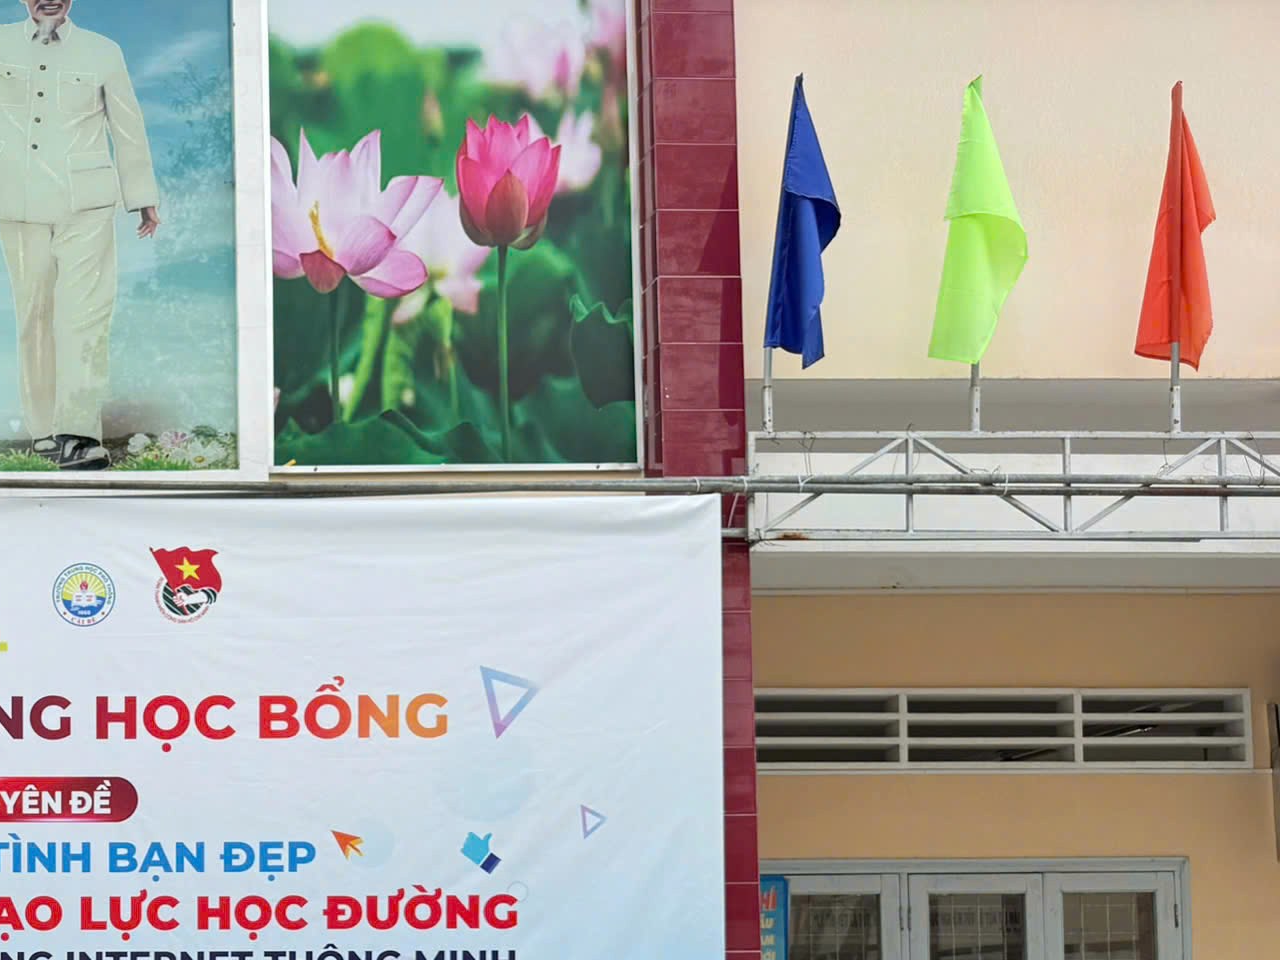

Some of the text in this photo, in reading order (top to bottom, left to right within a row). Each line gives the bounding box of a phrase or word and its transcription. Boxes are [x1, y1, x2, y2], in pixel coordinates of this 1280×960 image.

[95, 694, 236, 753] HỌC
[258, 676, 449, 740] BỔNG
[69, 780, 112, 815] ĐỀ
[109, 841, 210, 882] BẠN
[220, 841, 317, 882] ĐẸP
[80, 889, 180, 940] LỰC
[196, 895, 308, 940] HỌC
[323, 885, 519, 930] ĐƯỜNG
